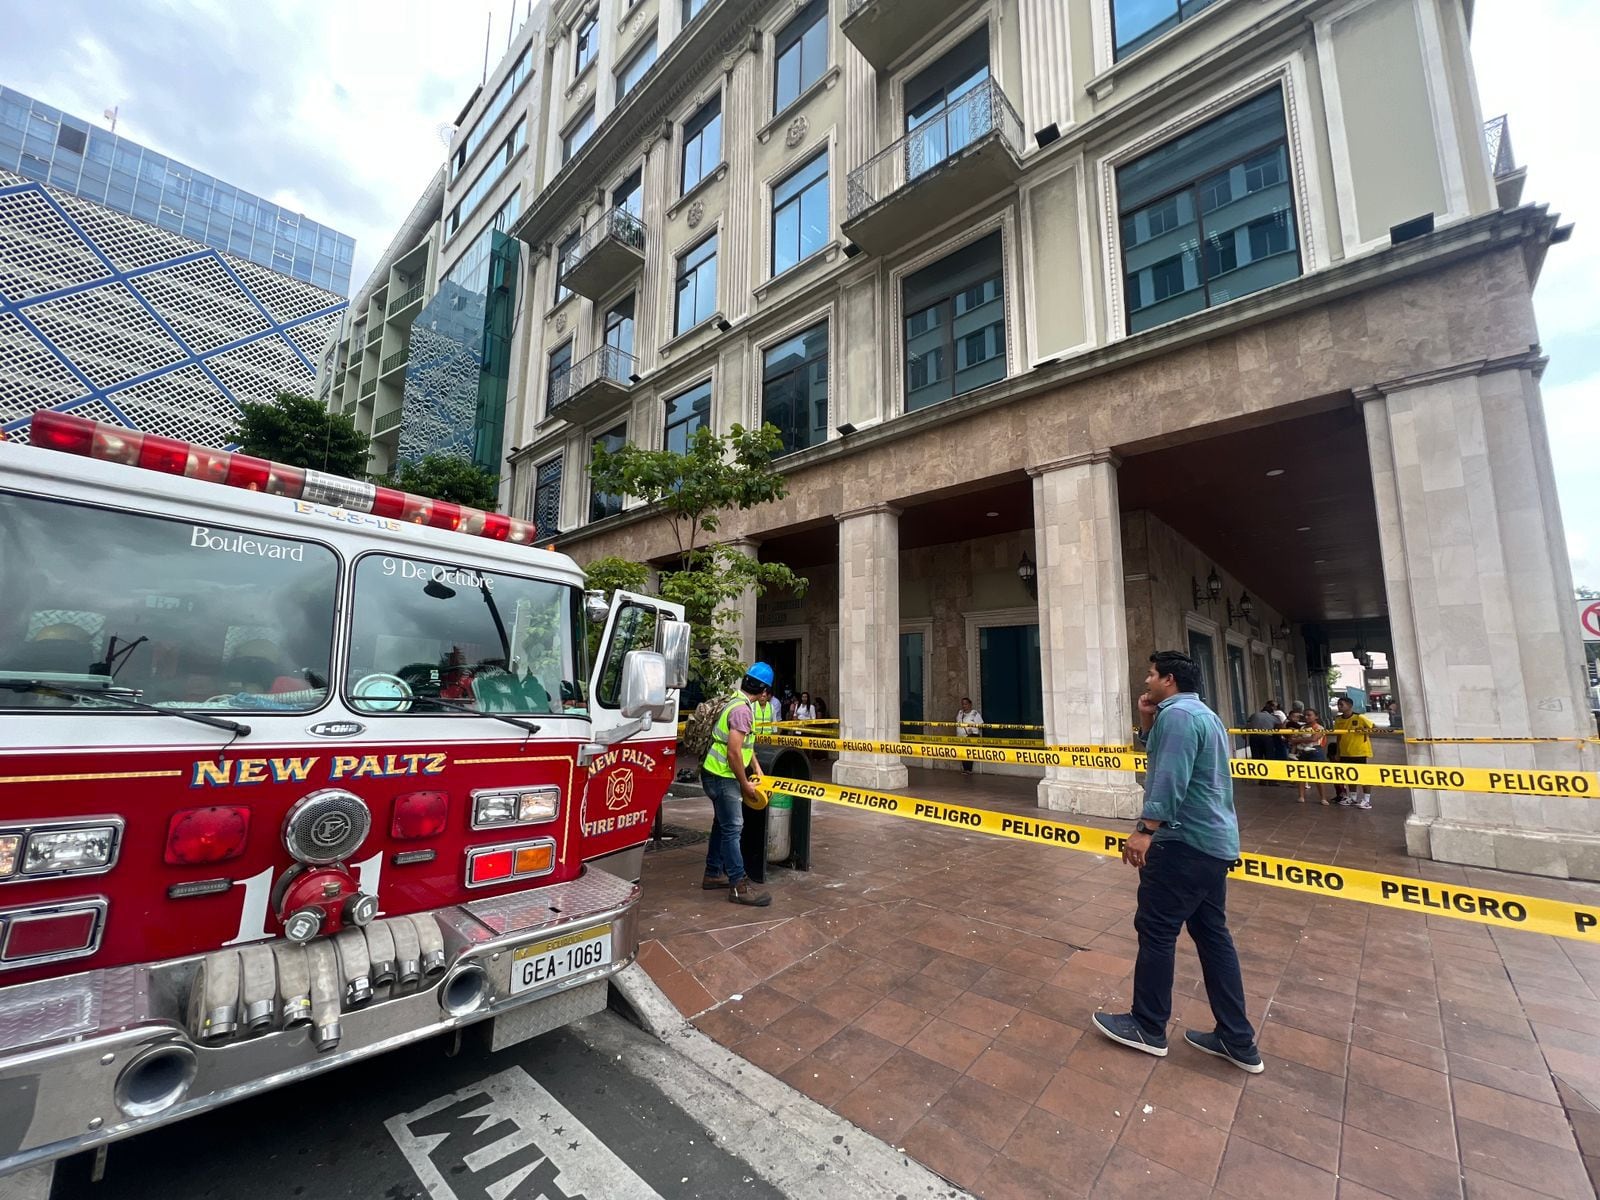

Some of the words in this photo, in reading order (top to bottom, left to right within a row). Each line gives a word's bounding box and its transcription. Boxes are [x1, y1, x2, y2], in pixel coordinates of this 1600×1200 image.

[190, 526, 304, 562] Boulevard
[382, 557, 396, 576] 9
[402, 559, 427, 581] De
[431, 564, 495, 590] Octubre
[588, 750, 619, 776] NEW
[621, 748, 656, 772] PALTZ
[777, 736, 803, 747] PELIGRO
[809, 738, 837, 750] PELIGRO
[843, 741, 873, 753] PELIGRO
[880, 743, 913, 755] PELIGRO
[921, 746, 957, 759] PELIGRO
[966, 748, 1006, 761] PELIGRO
[1016, 751, 1060, 765] PELIGRO
[1072, 754, 1121, 768] PELIGRO
[190, 756, 320, 788] NEW
[328, 751, 448, 782] PALTZ
[1230, 762, 1268, 777] IGRO
[1286, 764, 1359, 781] PELIGRO
[1380, 768, 1465, 787] PELIGRO
[1489, 772, 1589, 793] PELIGRO
[614, 783, 625, 795] 43
[583, 817, 615, 838] FIRE
[616, 809, 648, 830] DEPT.
[772, 780, 825, 798] PELIGRO
[839, 790, 898, 811] PELIGRO
[914, 803, 982, 826] PELIGRO
[1001, 818, 1080, 845] PELIGRO
[1229, 858, 1344, 891] PELIGRO
[1381, 880, 1527, 922] PELIGRO
[522, 941, 602, 986] GEA-1069
